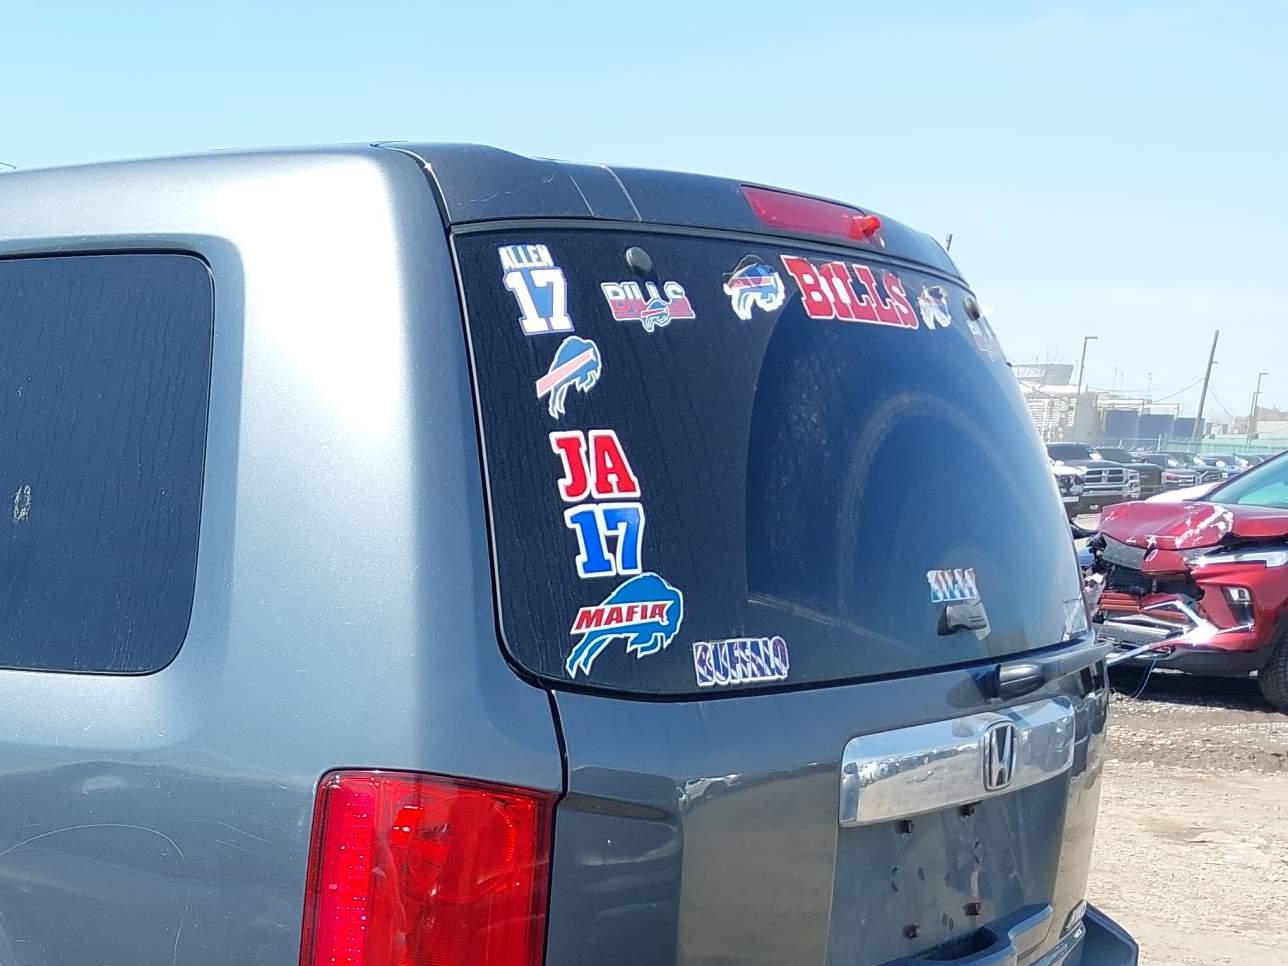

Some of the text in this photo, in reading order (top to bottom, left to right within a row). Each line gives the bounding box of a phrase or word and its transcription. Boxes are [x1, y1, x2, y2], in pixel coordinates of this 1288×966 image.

[499, 245, 555, 269] ALLEN
[502, 267, 575, 335] 17
[780, 254, 919, 329] BILLS
[549, 429, 641, 501] JA
[564, 503, 646, 578] 17
[575, 604, 665, 631] MAFIA
[693, 636, 790, 687] BUFFALO
